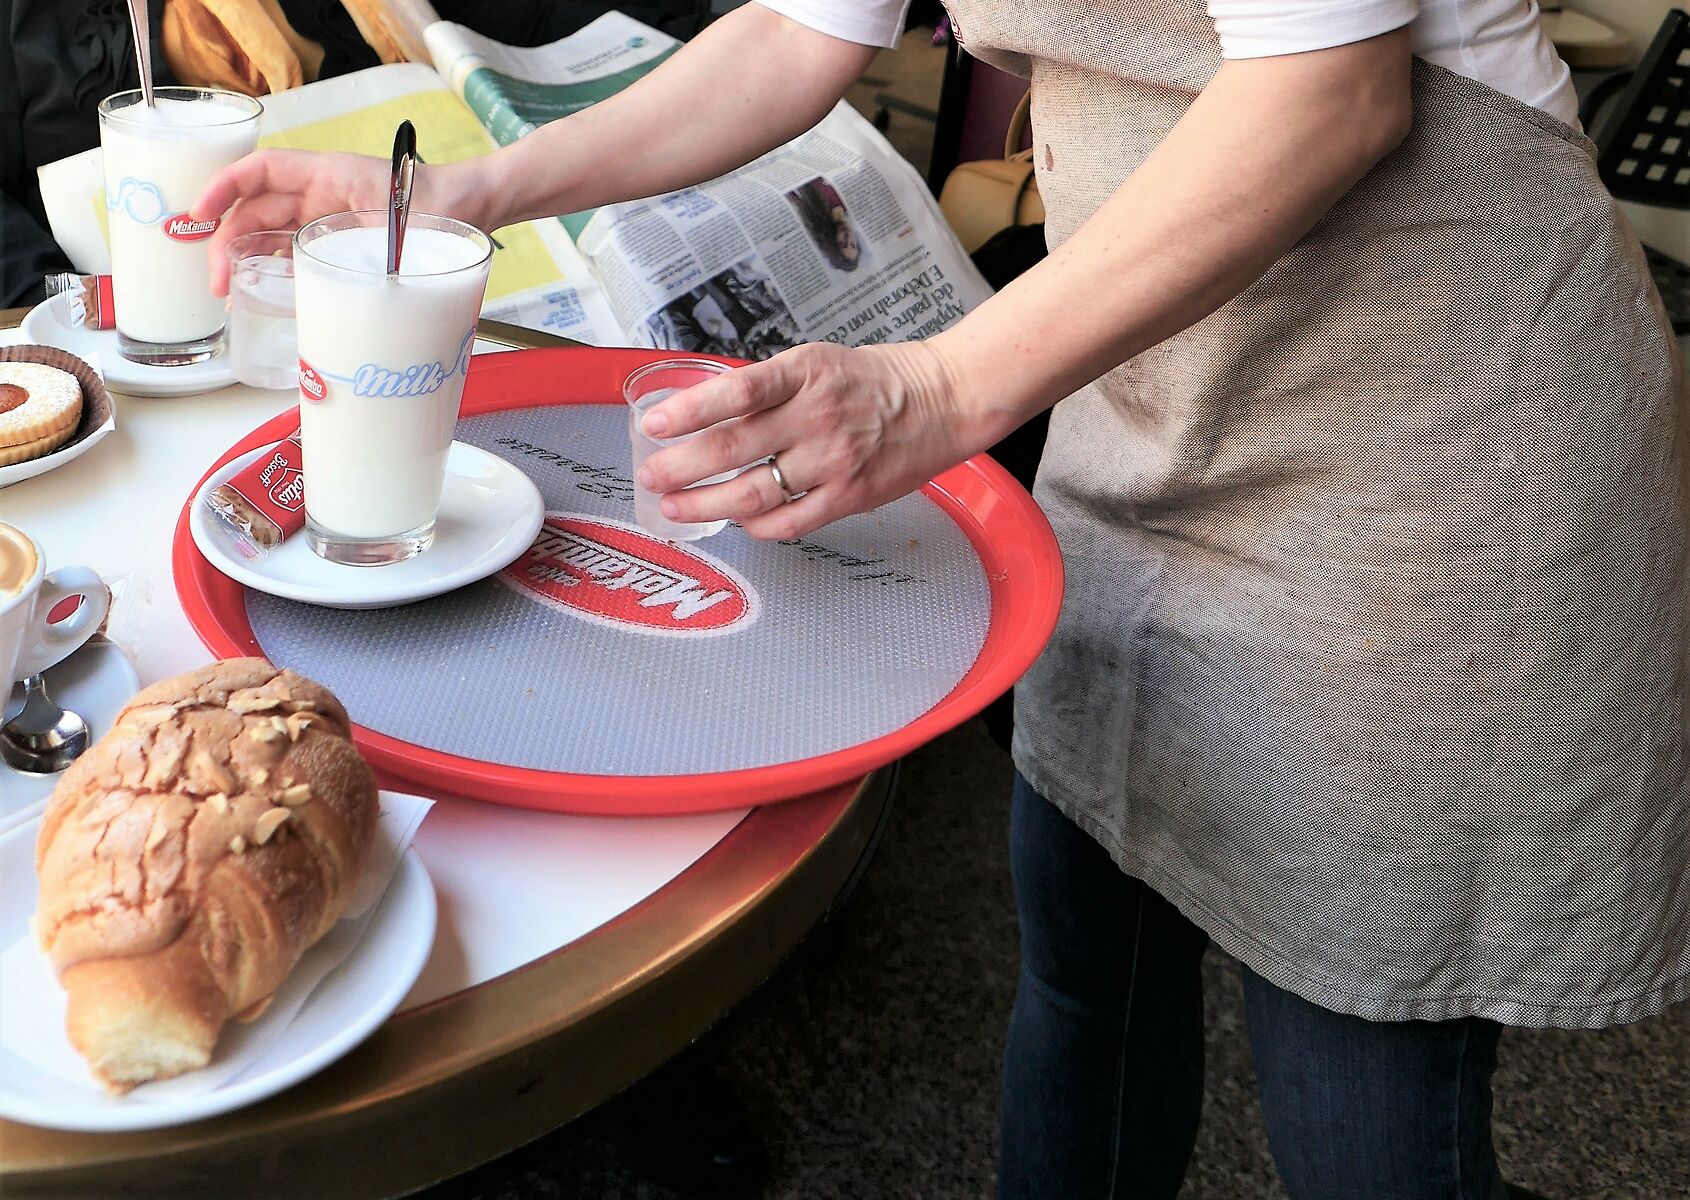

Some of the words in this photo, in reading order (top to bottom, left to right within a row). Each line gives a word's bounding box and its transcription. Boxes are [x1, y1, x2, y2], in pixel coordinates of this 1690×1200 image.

[928, 263, 945, 282] E
[873, 270, 933, 317] Deborah
[931, 282, 953, 308] del
[846, 305, 876, 332] non
[890, 292, 932, 330] padre
[259, 452, 288, 488] Biscoff
[278, 474, 304, 505] otus
[530, 527, 735, 622] Mokamb
